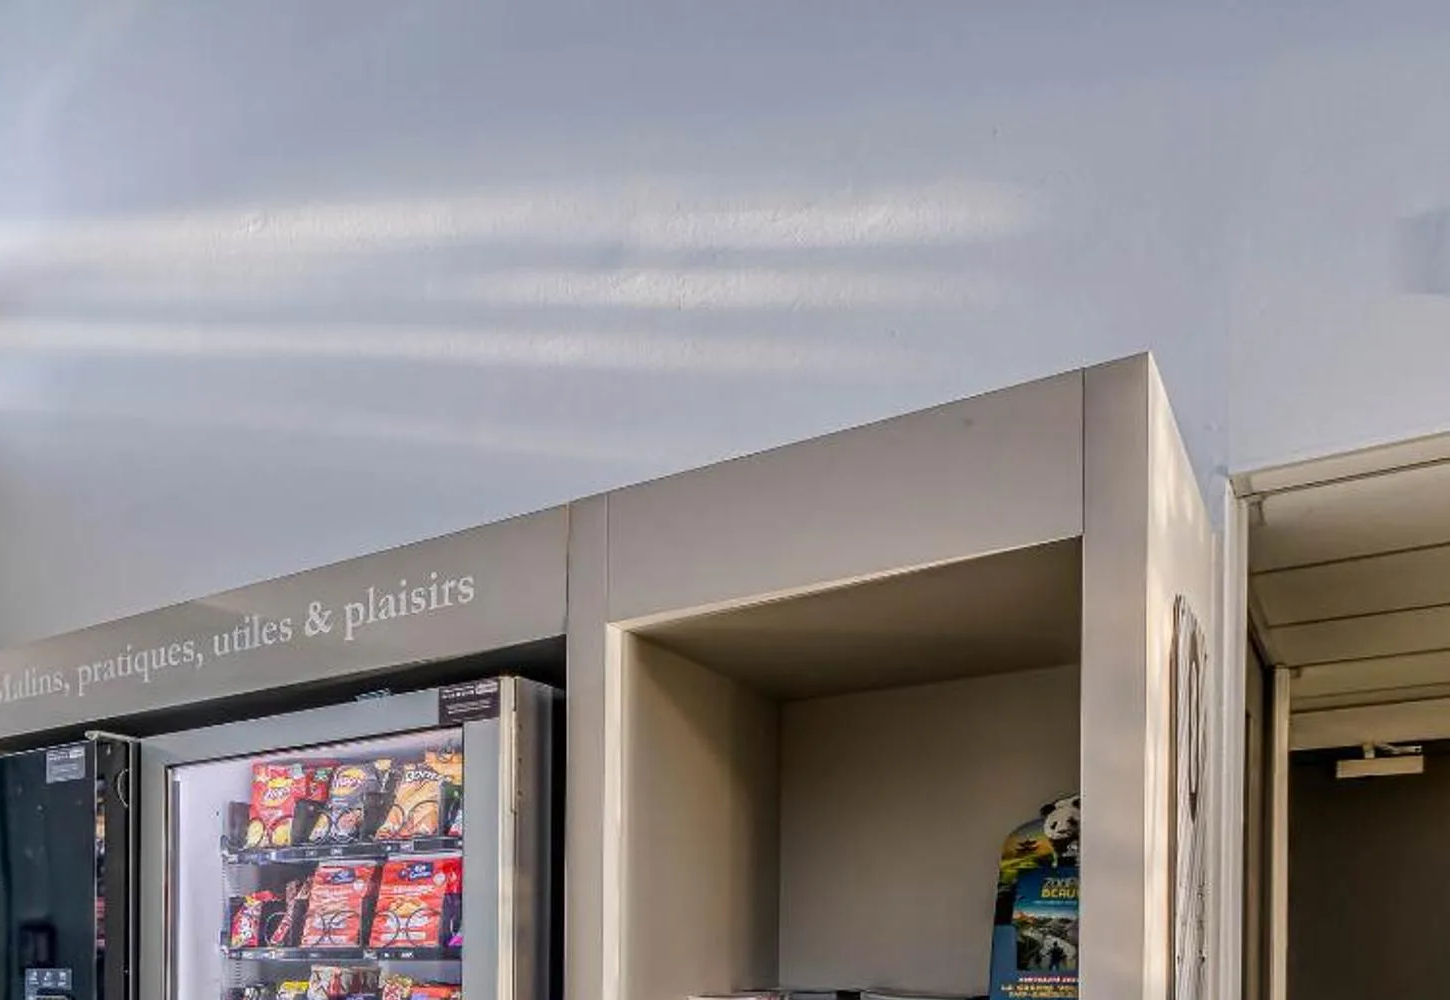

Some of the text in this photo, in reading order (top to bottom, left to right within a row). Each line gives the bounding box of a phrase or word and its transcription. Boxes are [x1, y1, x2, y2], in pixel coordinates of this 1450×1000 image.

[77, 640, 204, 697] pratiques,
[213, 614, 293, 654] utiles
[304, 601, 334, 638] &
[344, 571, 476, 641] plaisirs
